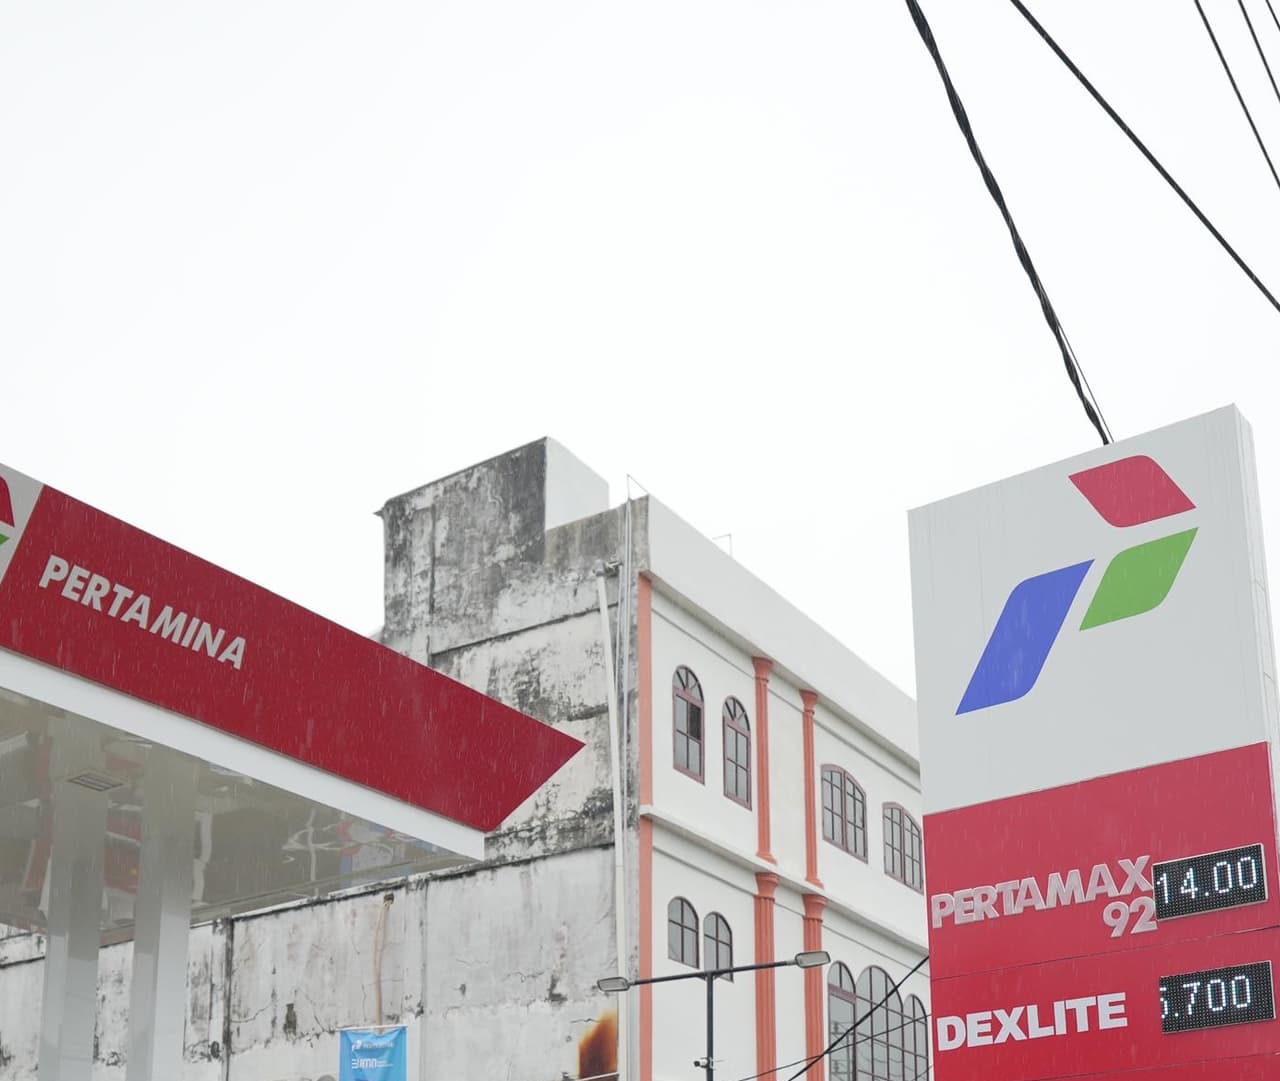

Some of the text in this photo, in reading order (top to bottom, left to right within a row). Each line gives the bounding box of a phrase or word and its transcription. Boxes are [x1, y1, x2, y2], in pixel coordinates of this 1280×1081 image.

[38, 554, 247, 670] PERTAMINA
[931, 855, 1154, 929] PERTAMAX
[1156, 856, 1258, 904] 14.00
[1102, 895, 1158, 938] 92
[936, 992, 1128, 1051] DEXLITE
